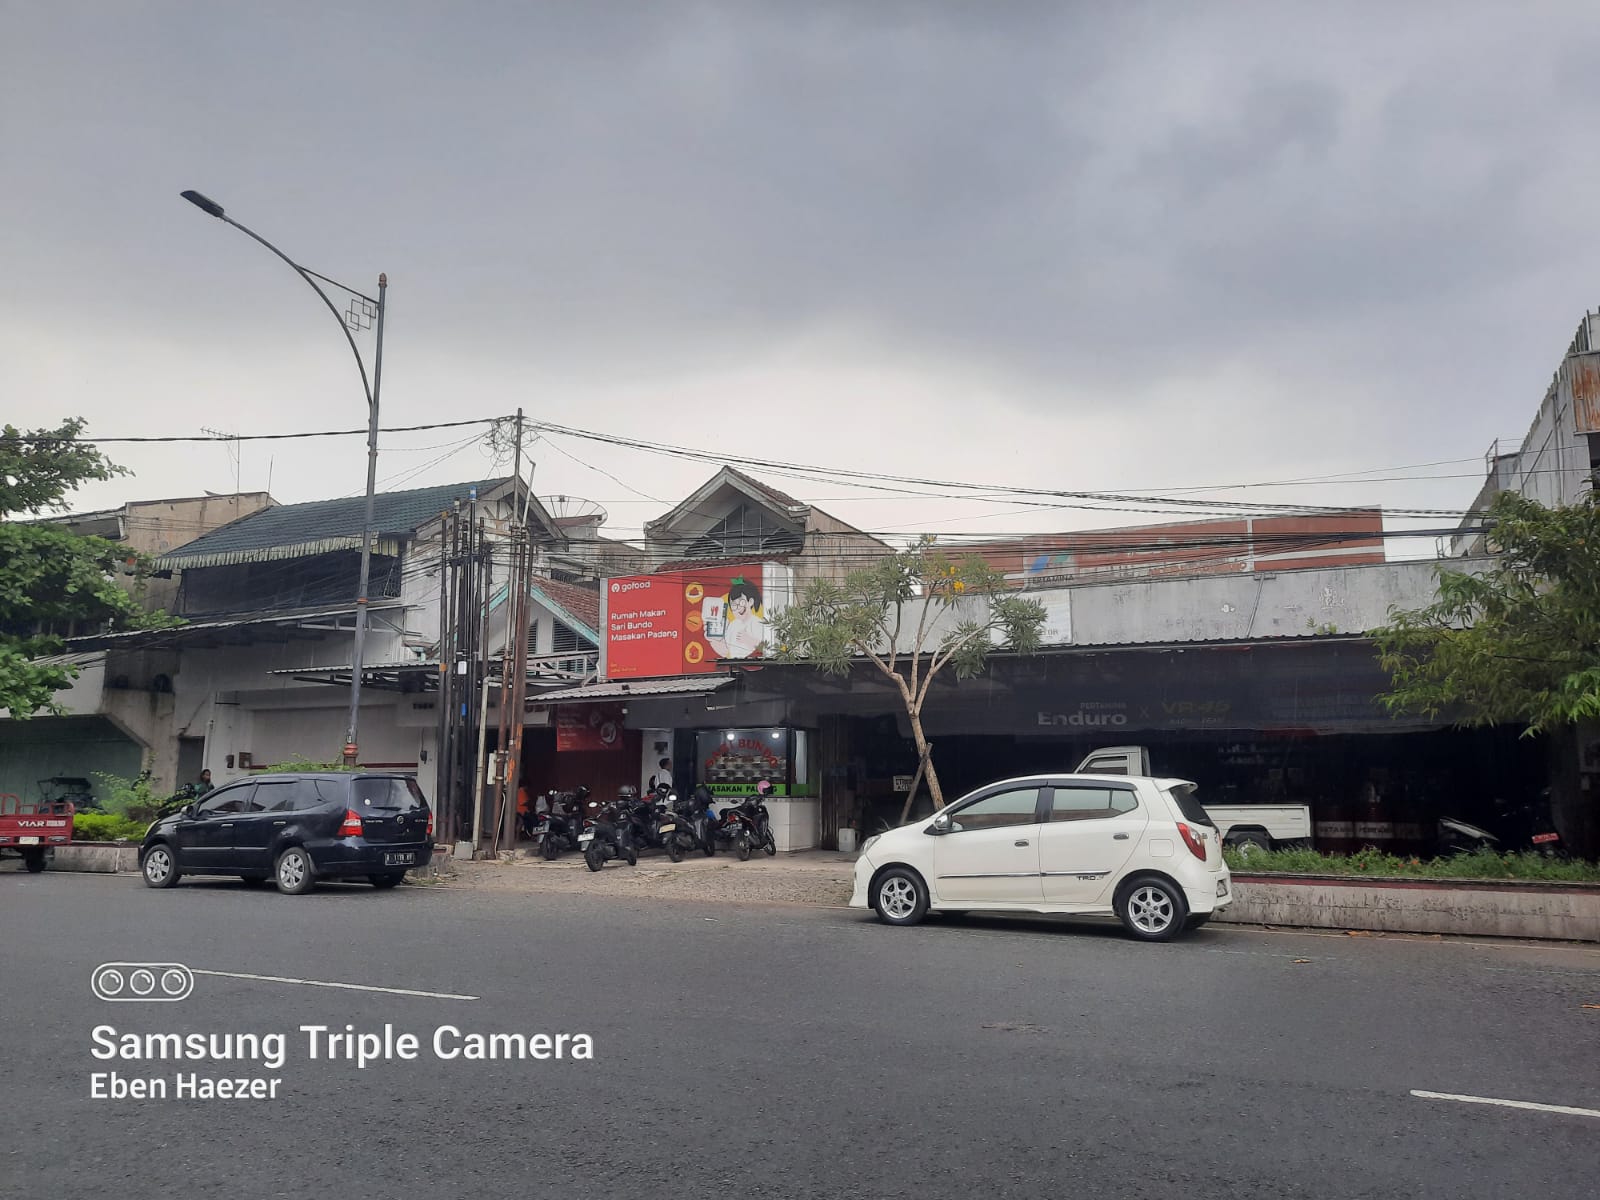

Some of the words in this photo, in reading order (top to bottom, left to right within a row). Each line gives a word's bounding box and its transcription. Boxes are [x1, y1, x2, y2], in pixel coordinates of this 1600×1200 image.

[621, 581, 651, 592] gofood
[611, 611, 638, 620] Rumah
[639, 609, 666, 618] Makan
[611, 622, 626, 631] Sari
[627, 621, 653, 630] Bundo
[611, 632, 646, 641] Masakan
[647, 630, 678, 639] Padang
[1037, 710, 1128, 725] Enduro
